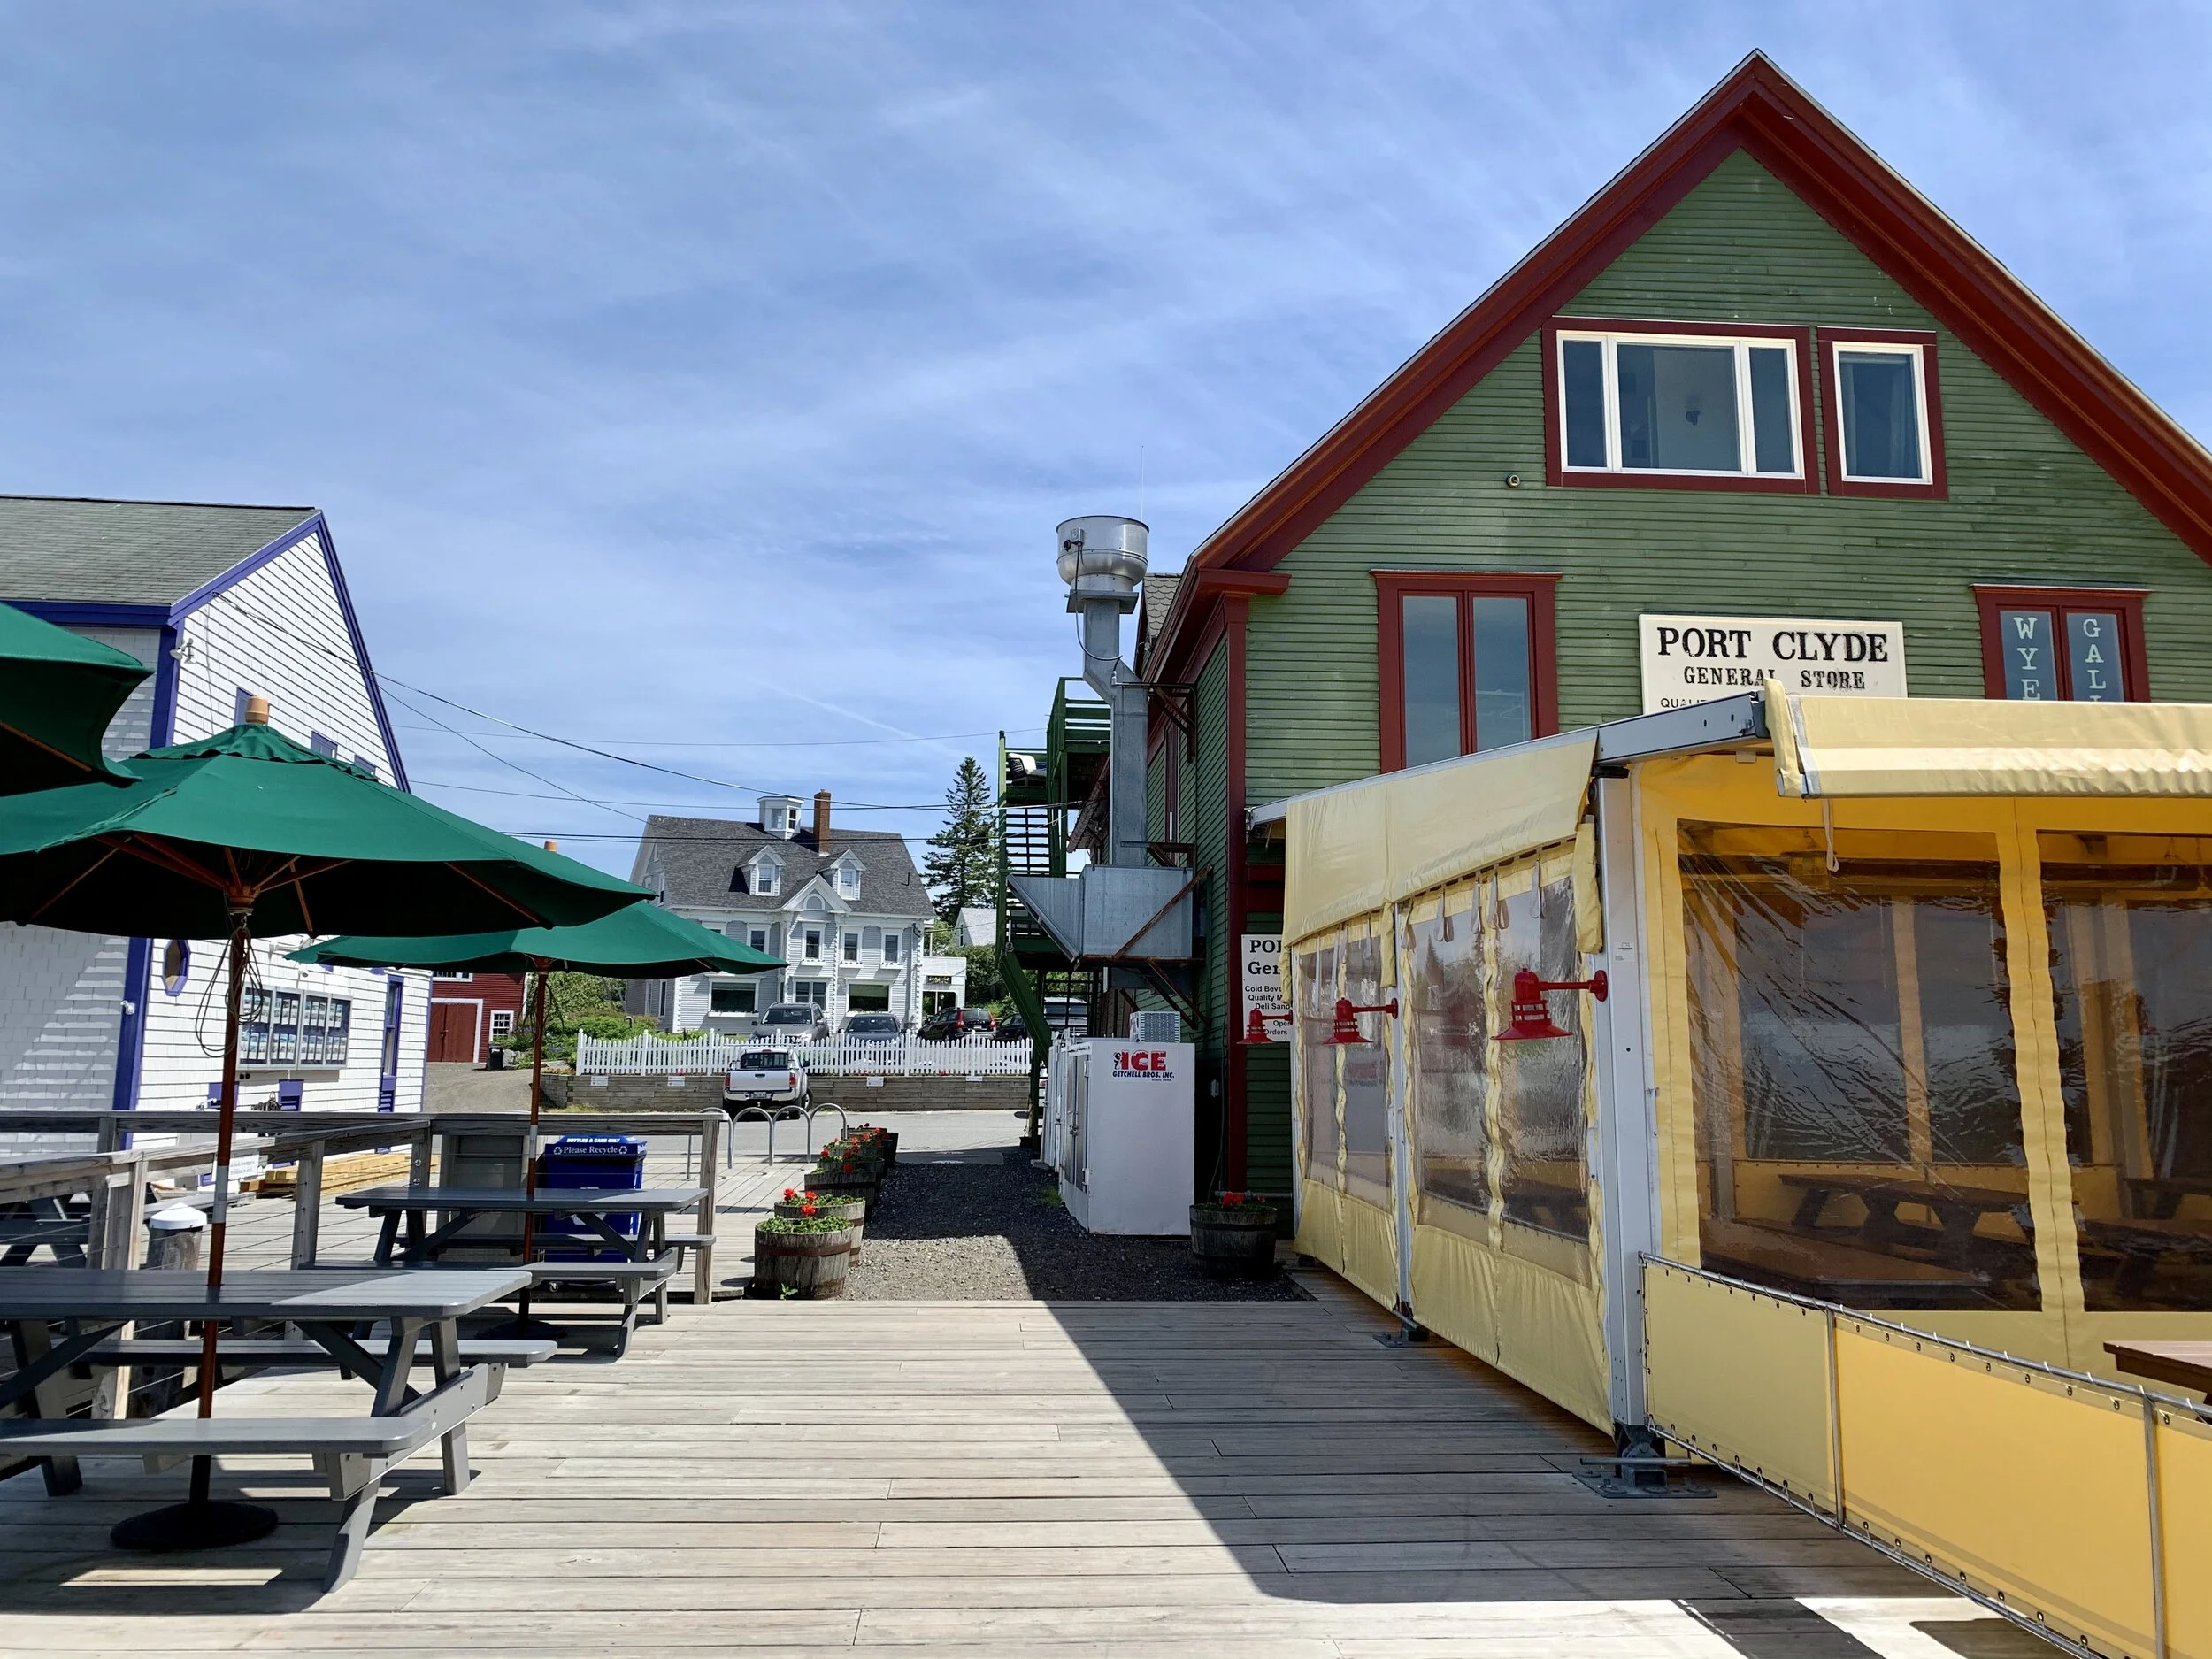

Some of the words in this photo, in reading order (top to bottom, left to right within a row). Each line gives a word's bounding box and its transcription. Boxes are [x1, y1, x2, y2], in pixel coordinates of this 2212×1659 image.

[1656, 626, 1752, 658] PORT
[1772, 631, 1888, 662] CLYDE
[1801, 670, 1865, 689] STORE
[1121, 1049, 1167, 1071] ICE
[588, 1146, 618, 1155] Recycle
